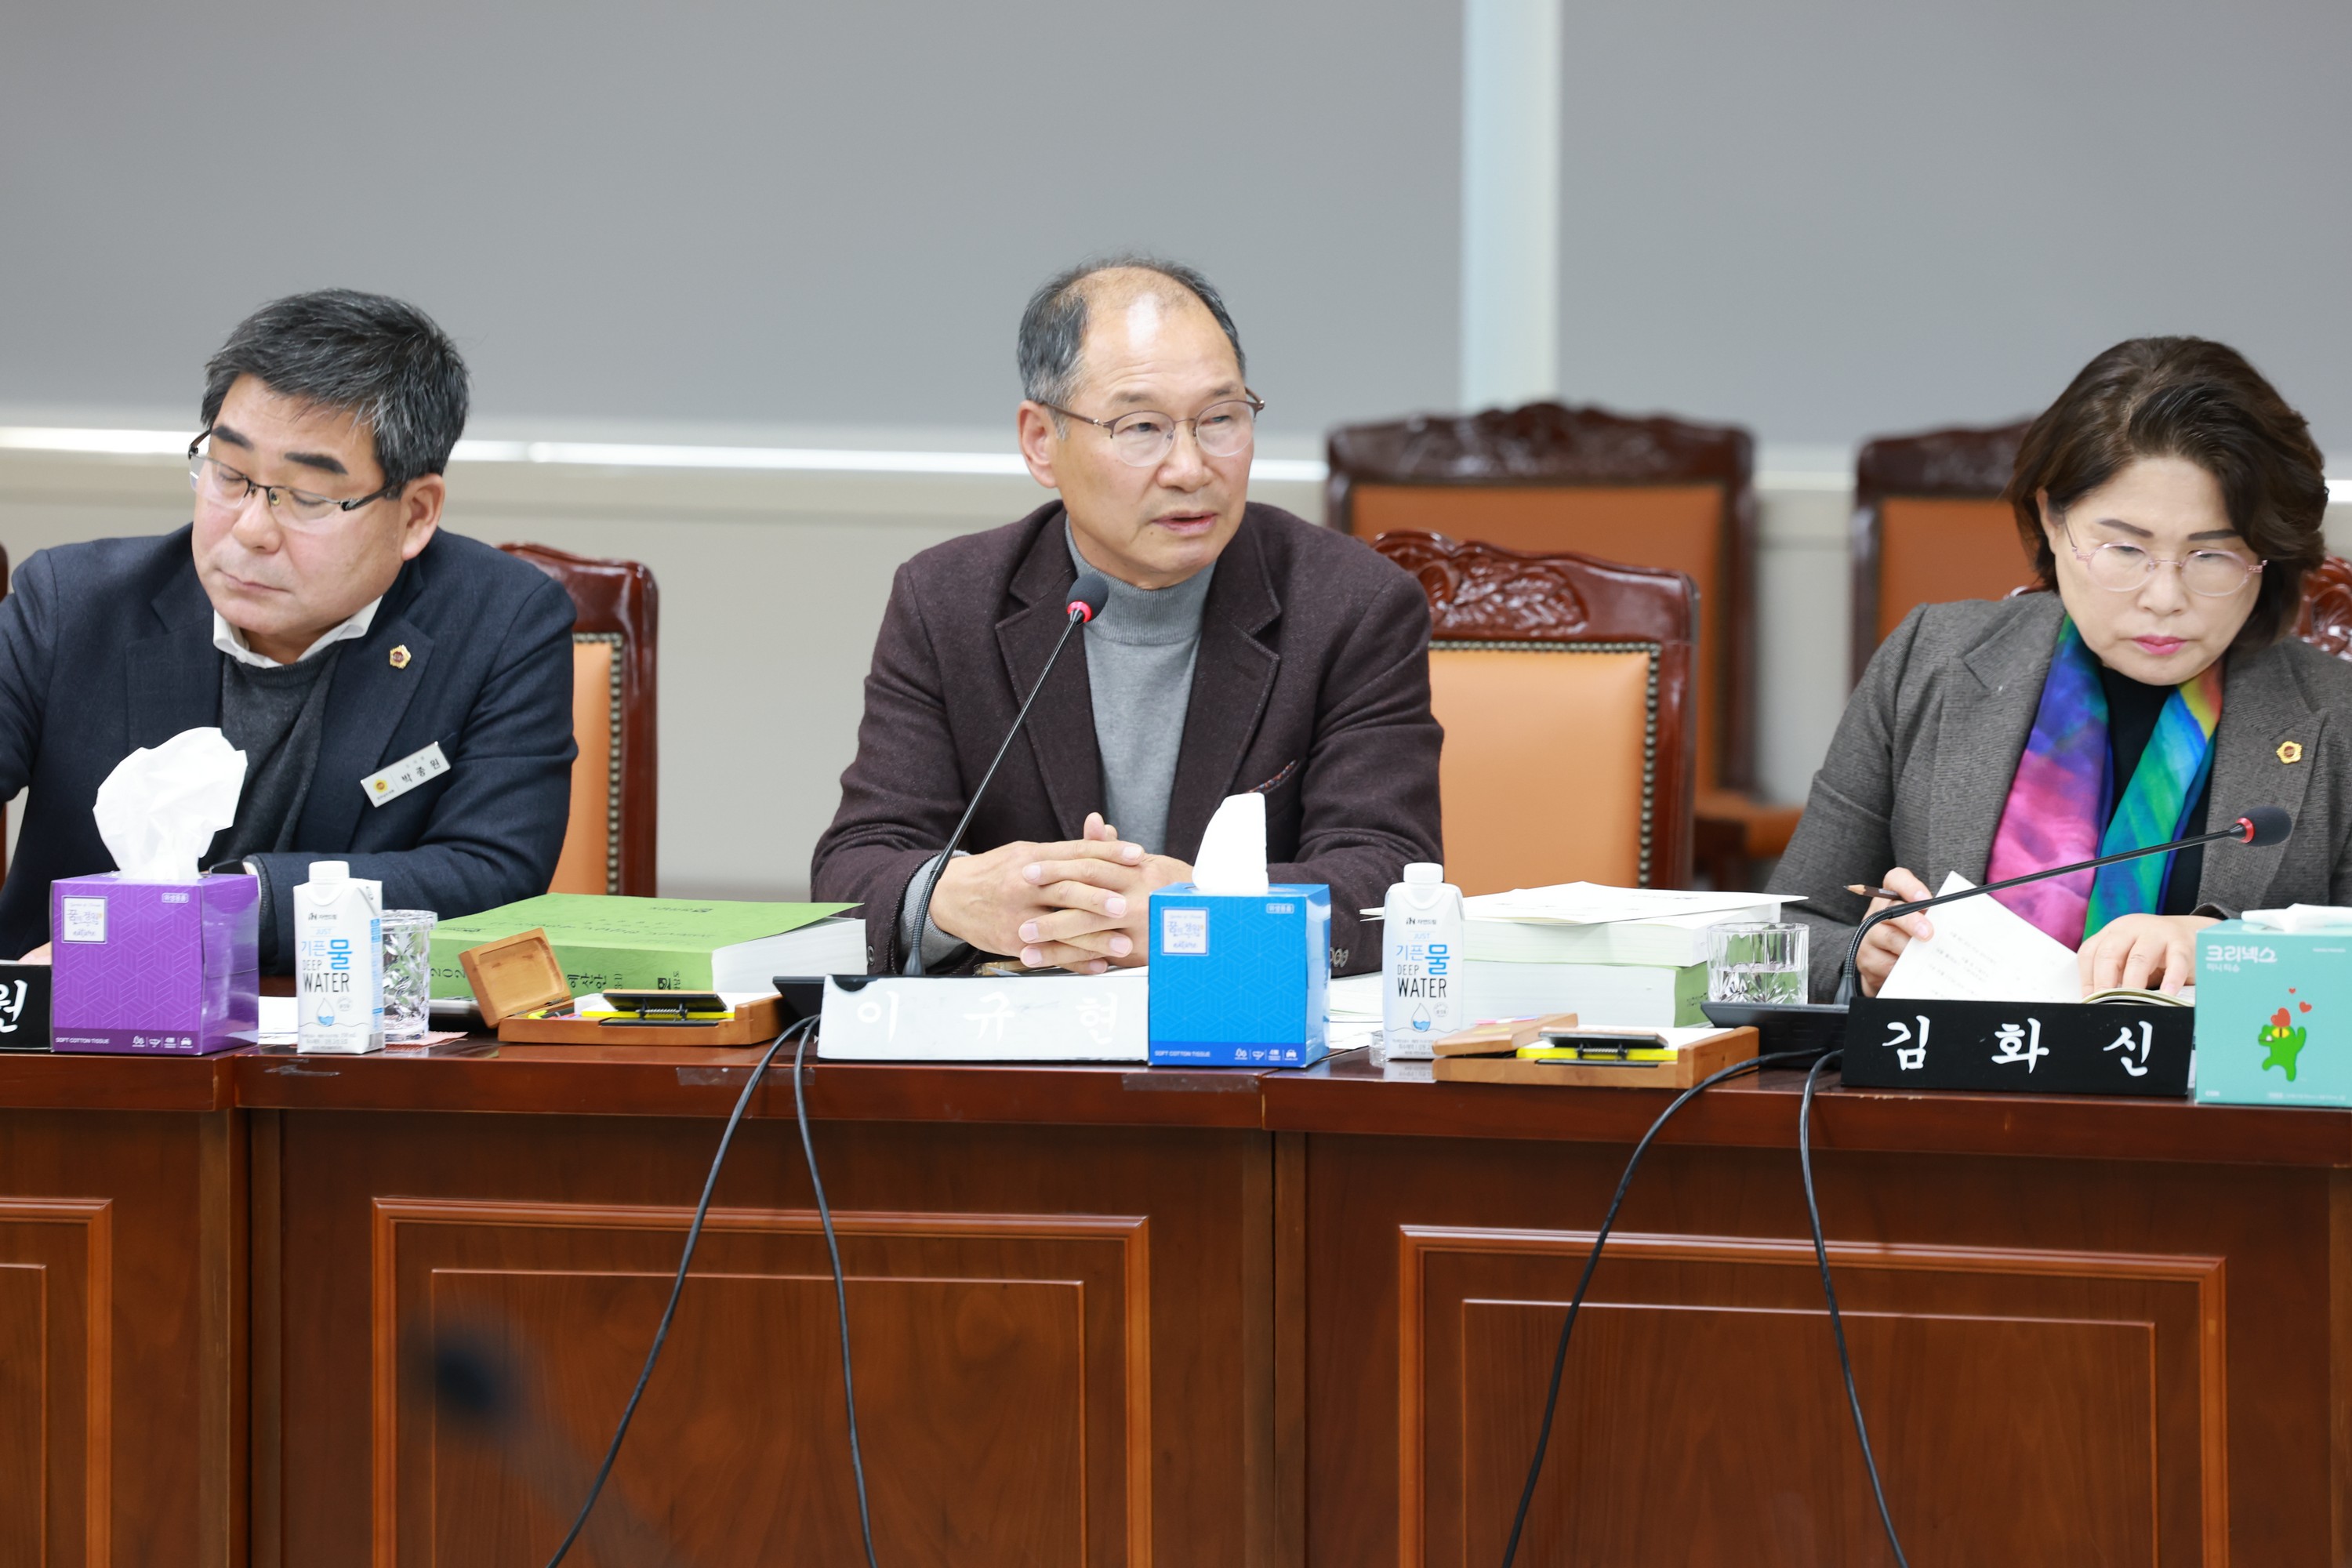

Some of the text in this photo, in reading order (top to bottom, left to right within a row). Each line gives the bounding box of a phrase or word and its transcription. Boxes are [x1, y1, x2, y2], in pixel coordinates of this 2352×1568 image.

[301, 939, 353, 970] 기픈 물
[1396, 944, 1450, 975] 기픈 물
[2205, 945, 2278, 964] 크리넥스
[303, 960, 323, 971] DEEP
[1397, 964, 1420, 975] DEEP
[303, 972, 350, 993] WATER
[1397, 977, 1447, 998] WATER
